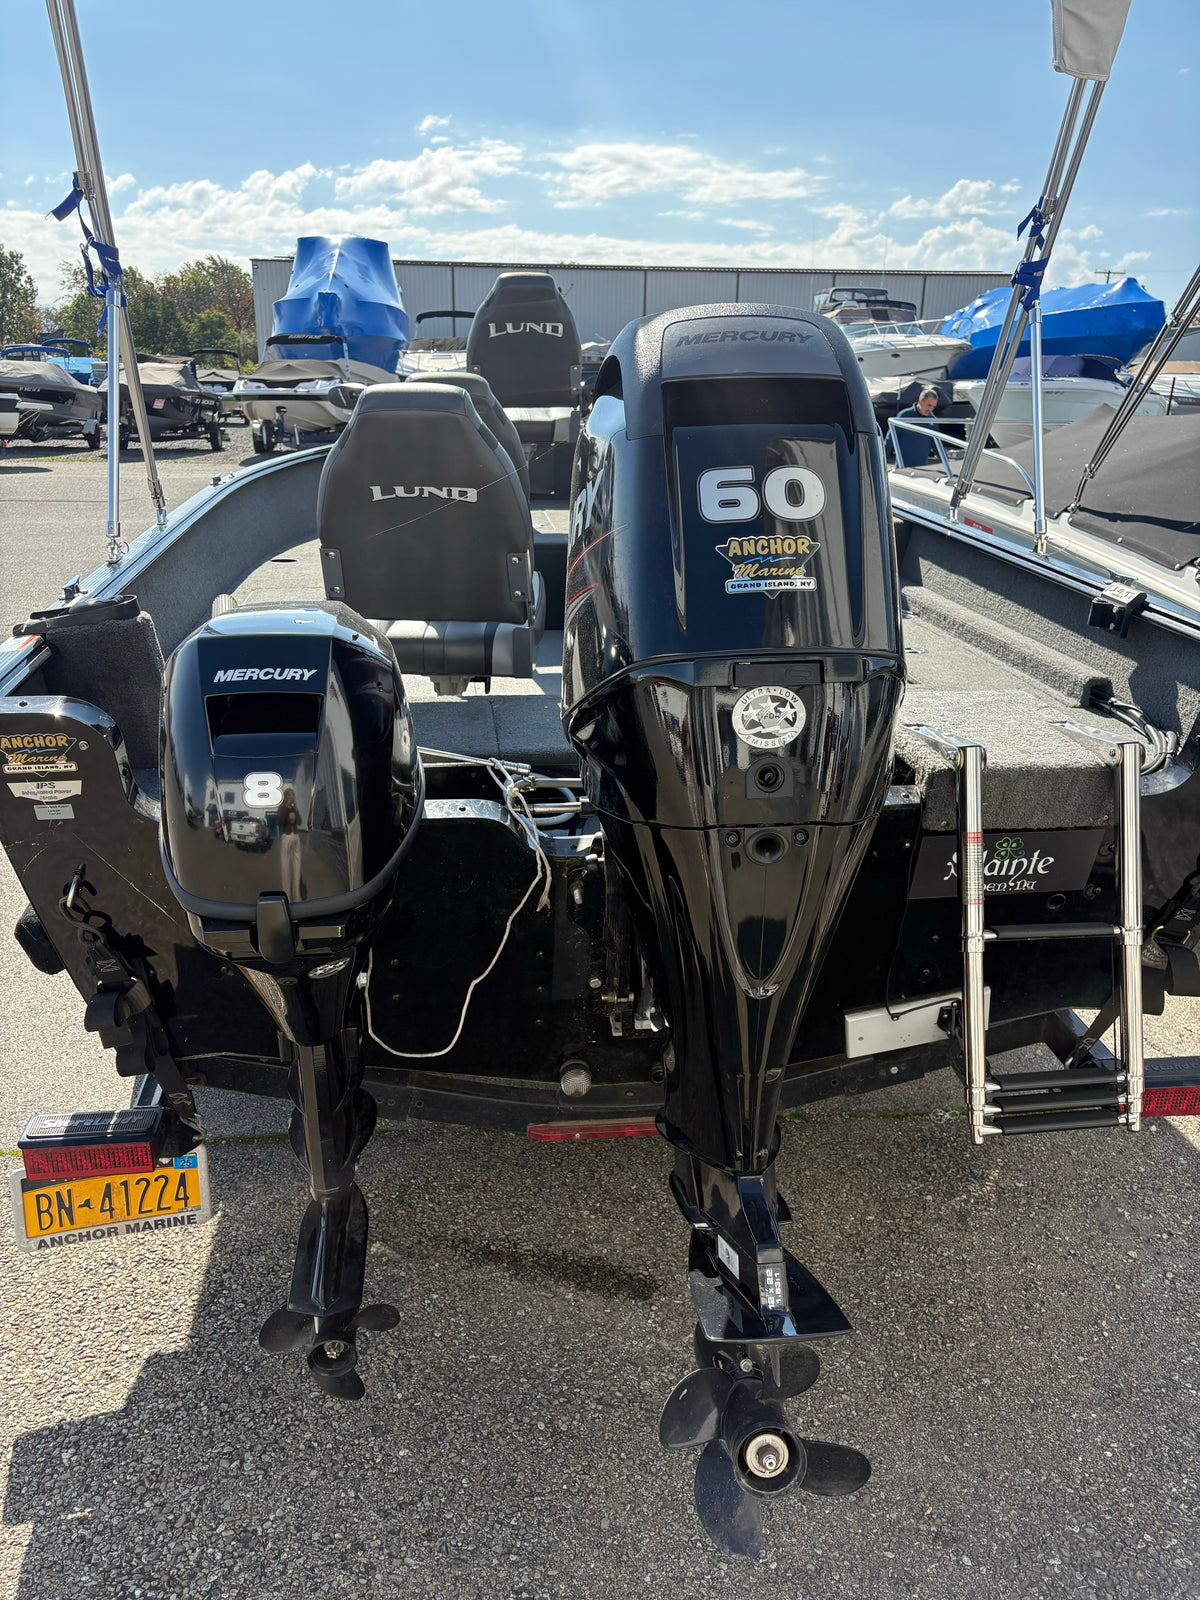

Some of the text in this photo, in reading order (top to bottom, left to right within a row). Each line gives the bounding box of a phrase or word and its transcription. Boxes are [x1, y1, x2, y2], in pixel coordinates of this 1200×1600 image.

[488, 322, 564, 338] LUND
[676, 330, 814, 348] MERCURY
[369, 485, 478, 503] LUND
[697, 465, 826, 524] 60
[728, 538, 810, 557] ANCHOR
[733, 563, 804, 578] Marine
[213, 667, 318, 683] MERCURY
[741, 688, 799, 705] ULTRA LOW
[0, 735, 69, 750] ANCHOR
[8, 753, 66, 764] Marine
[243, 771, 284, 809] 8
[180, 1159, 192, 1167] 25
[35, 1172, 190, 1231] BN 41224
[37, 1214, 197, 1249] ANCHOR MARINE
